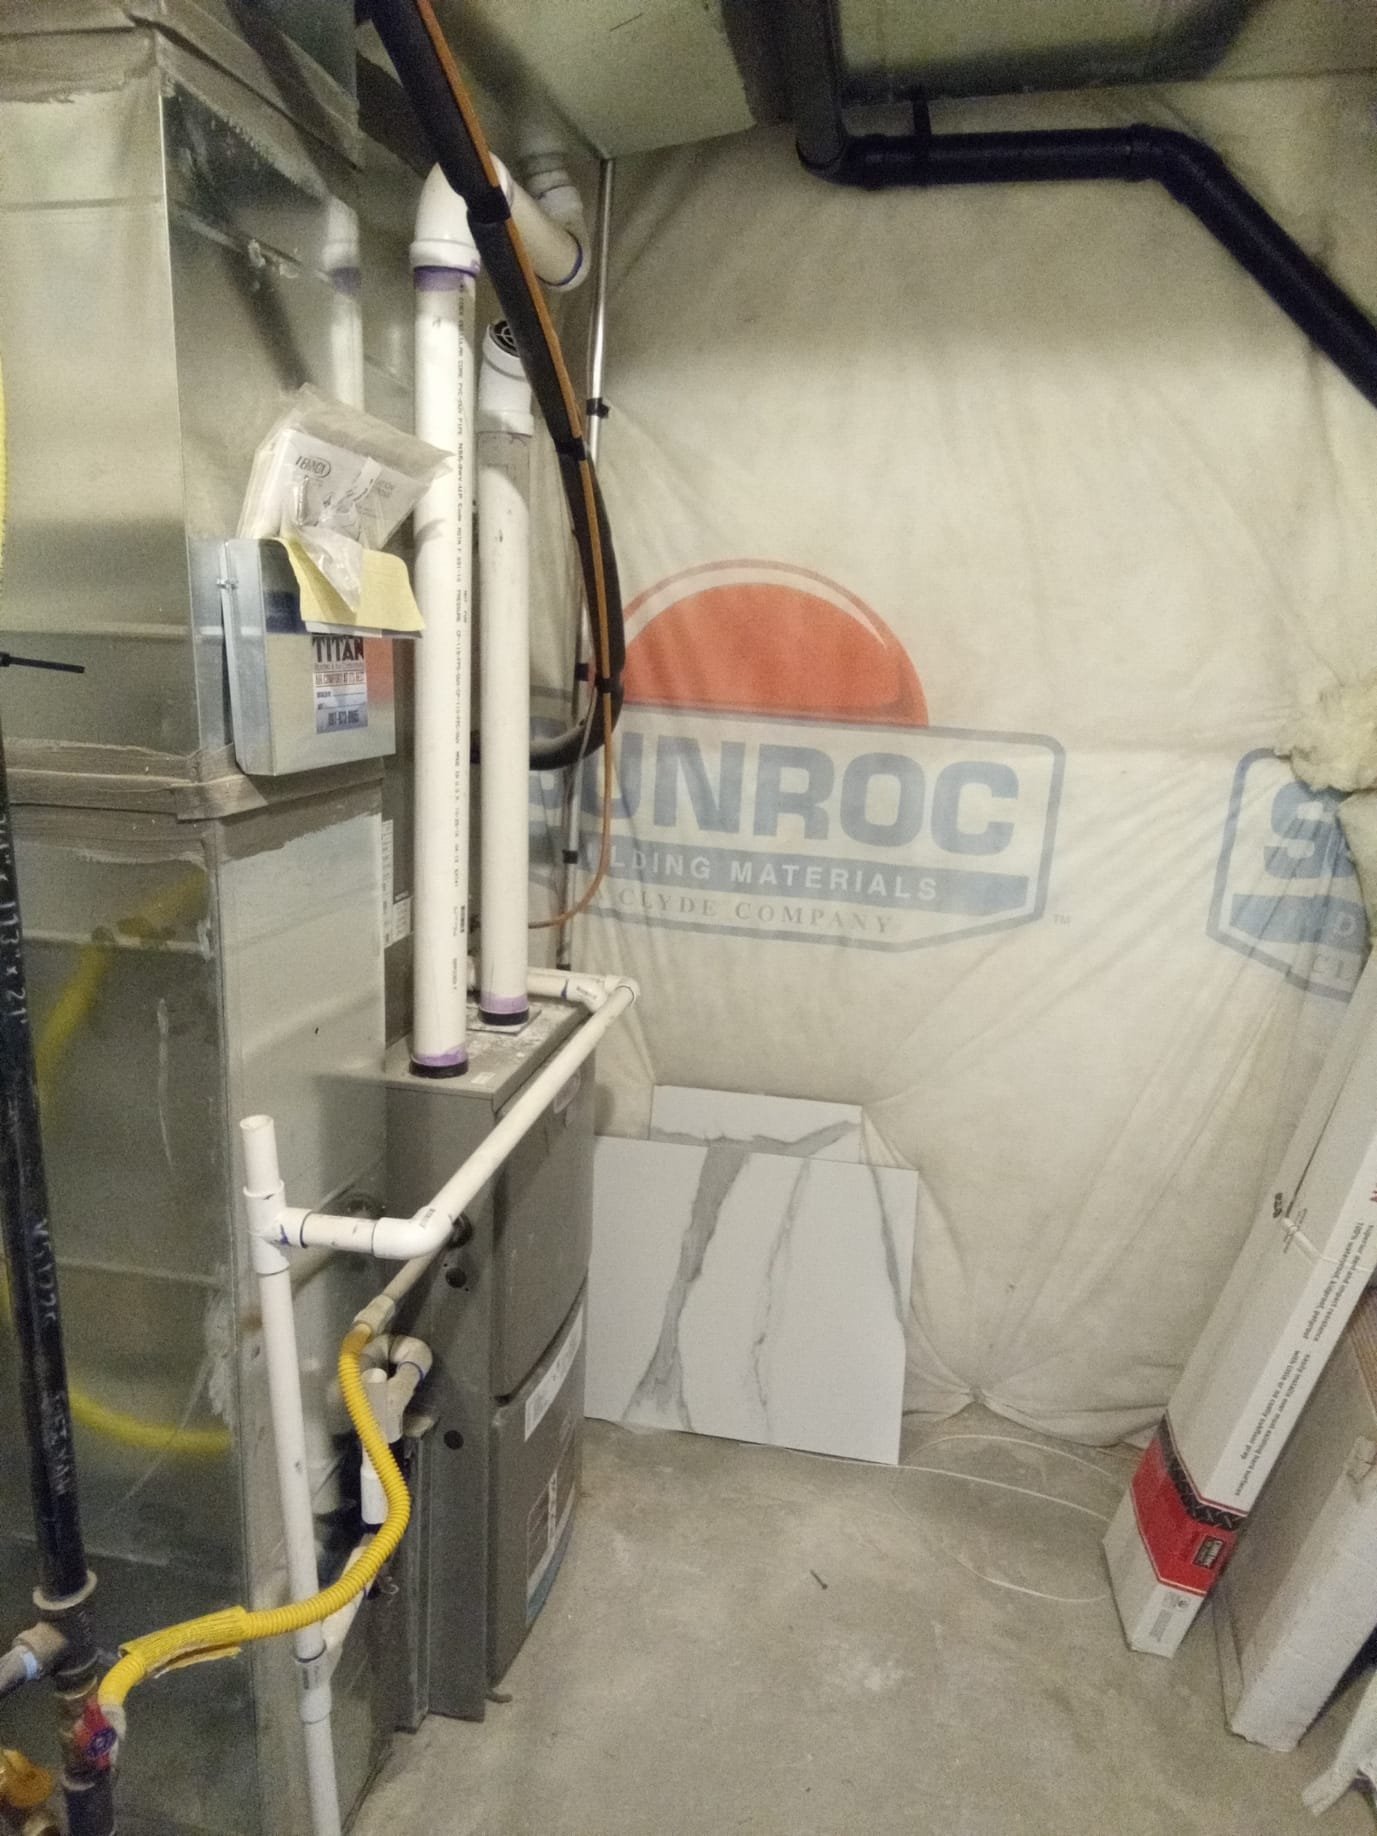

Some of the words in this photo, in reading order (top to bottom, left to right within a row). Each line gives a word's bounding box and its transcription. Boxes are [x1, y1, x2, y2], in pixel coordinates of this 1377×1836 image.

[312, 632, 364, 662] TITAN
[730, 860, 937, 900] MATERIALS
[618, 887, 718, 917] CLYDE
[735, 901, 891, 933] COMPANY
